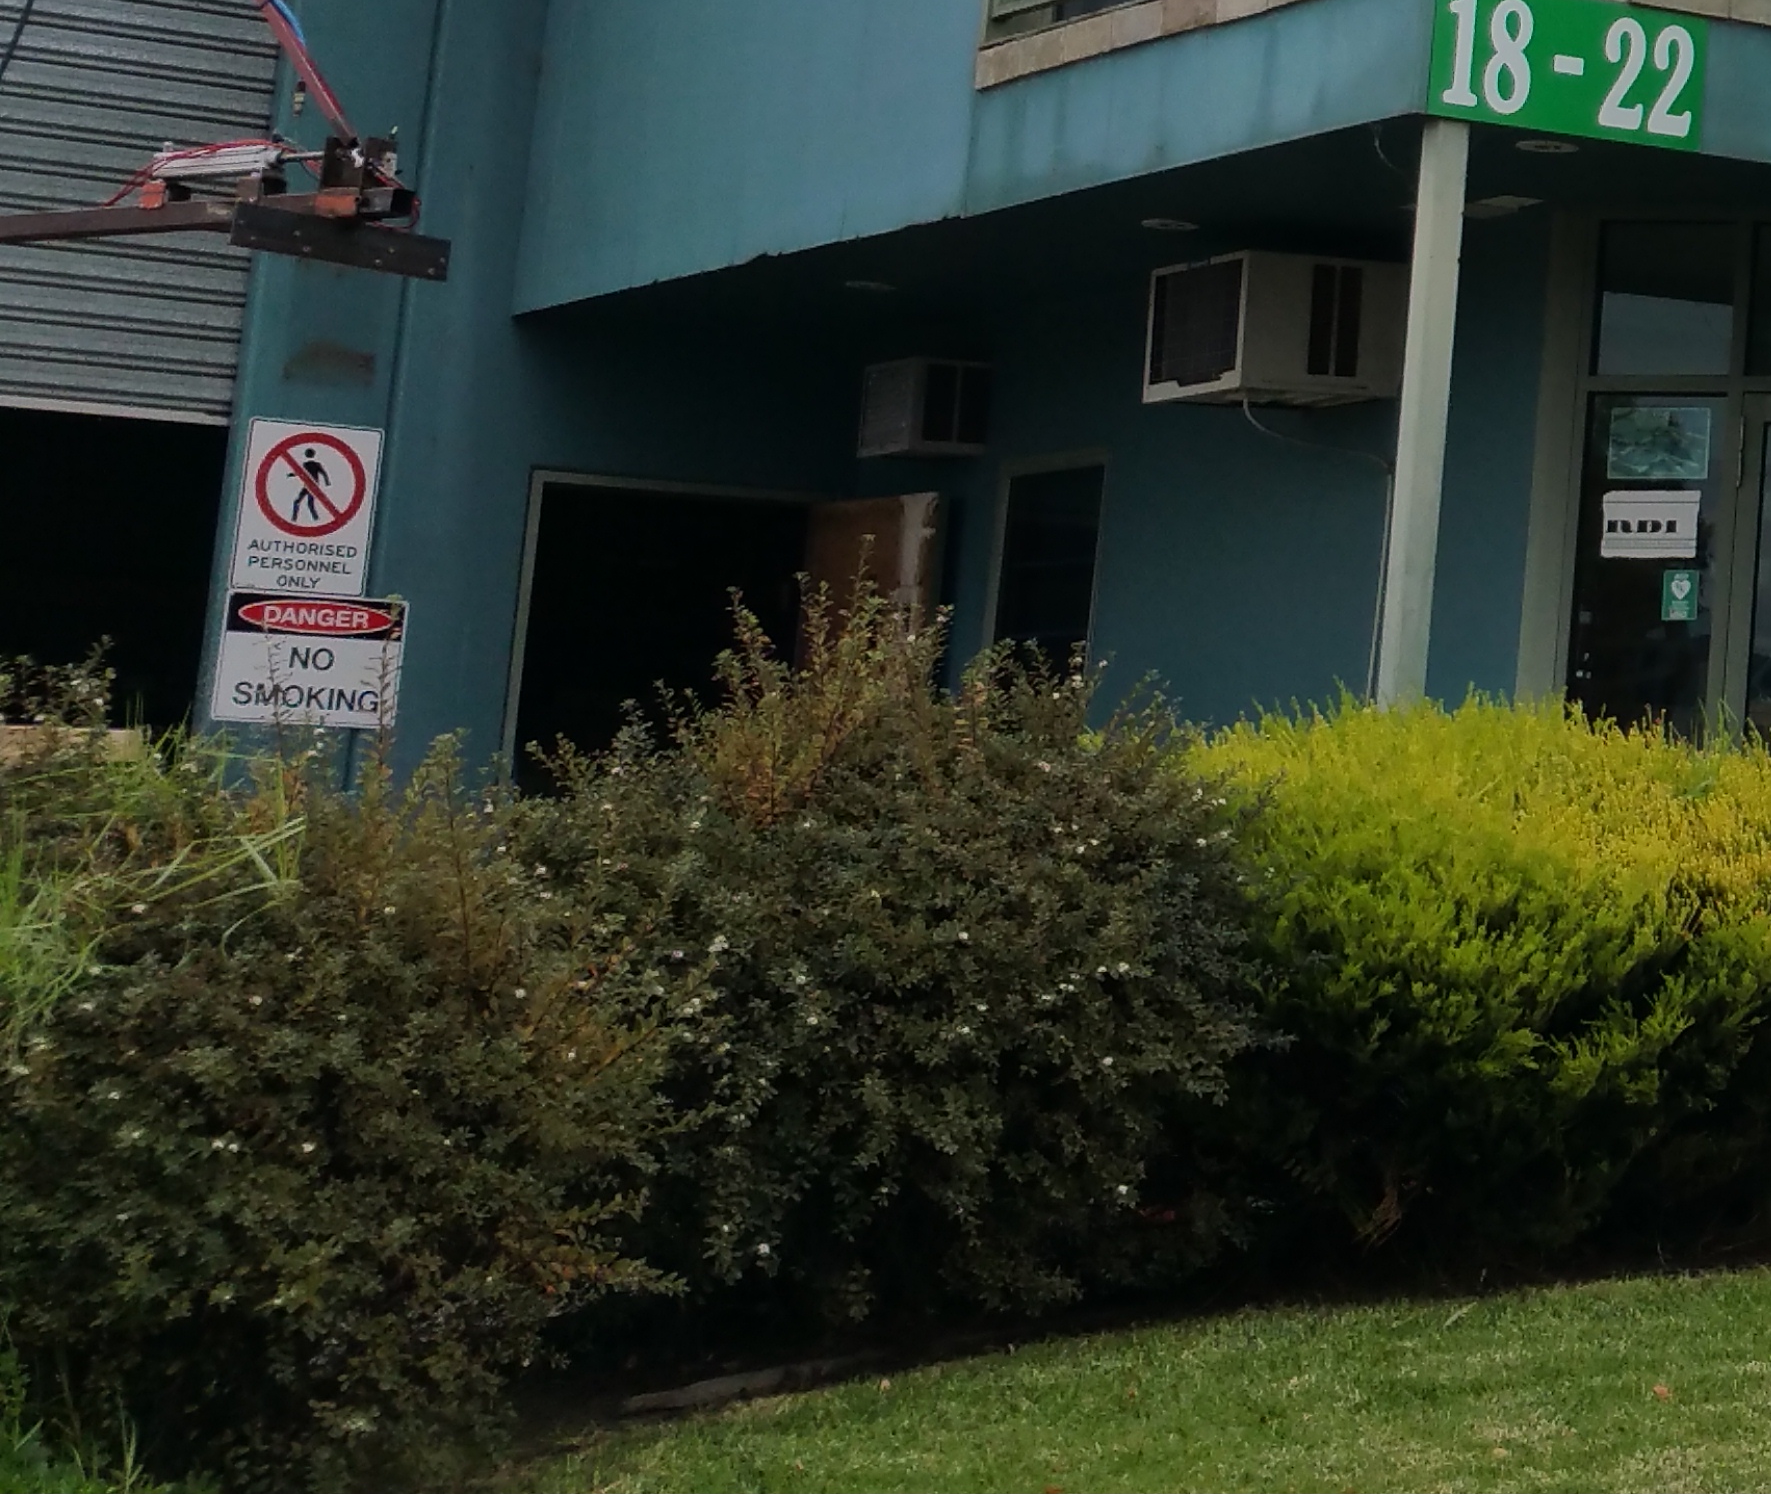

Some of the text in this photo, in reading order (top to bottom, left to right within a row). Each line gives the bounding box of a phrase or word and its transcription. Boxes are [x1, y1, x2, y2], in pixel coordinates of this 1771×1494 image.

[247, 539, 358, 559] AUTHORISED
[247, 555, 352, 575] PERSONNEL
[276, 574, 321, 589] ONLY
[263, 605, 369, 629] DANGER
[288, 646, 335, 671] NO
[232, 681, 379, 714] SMOKING
